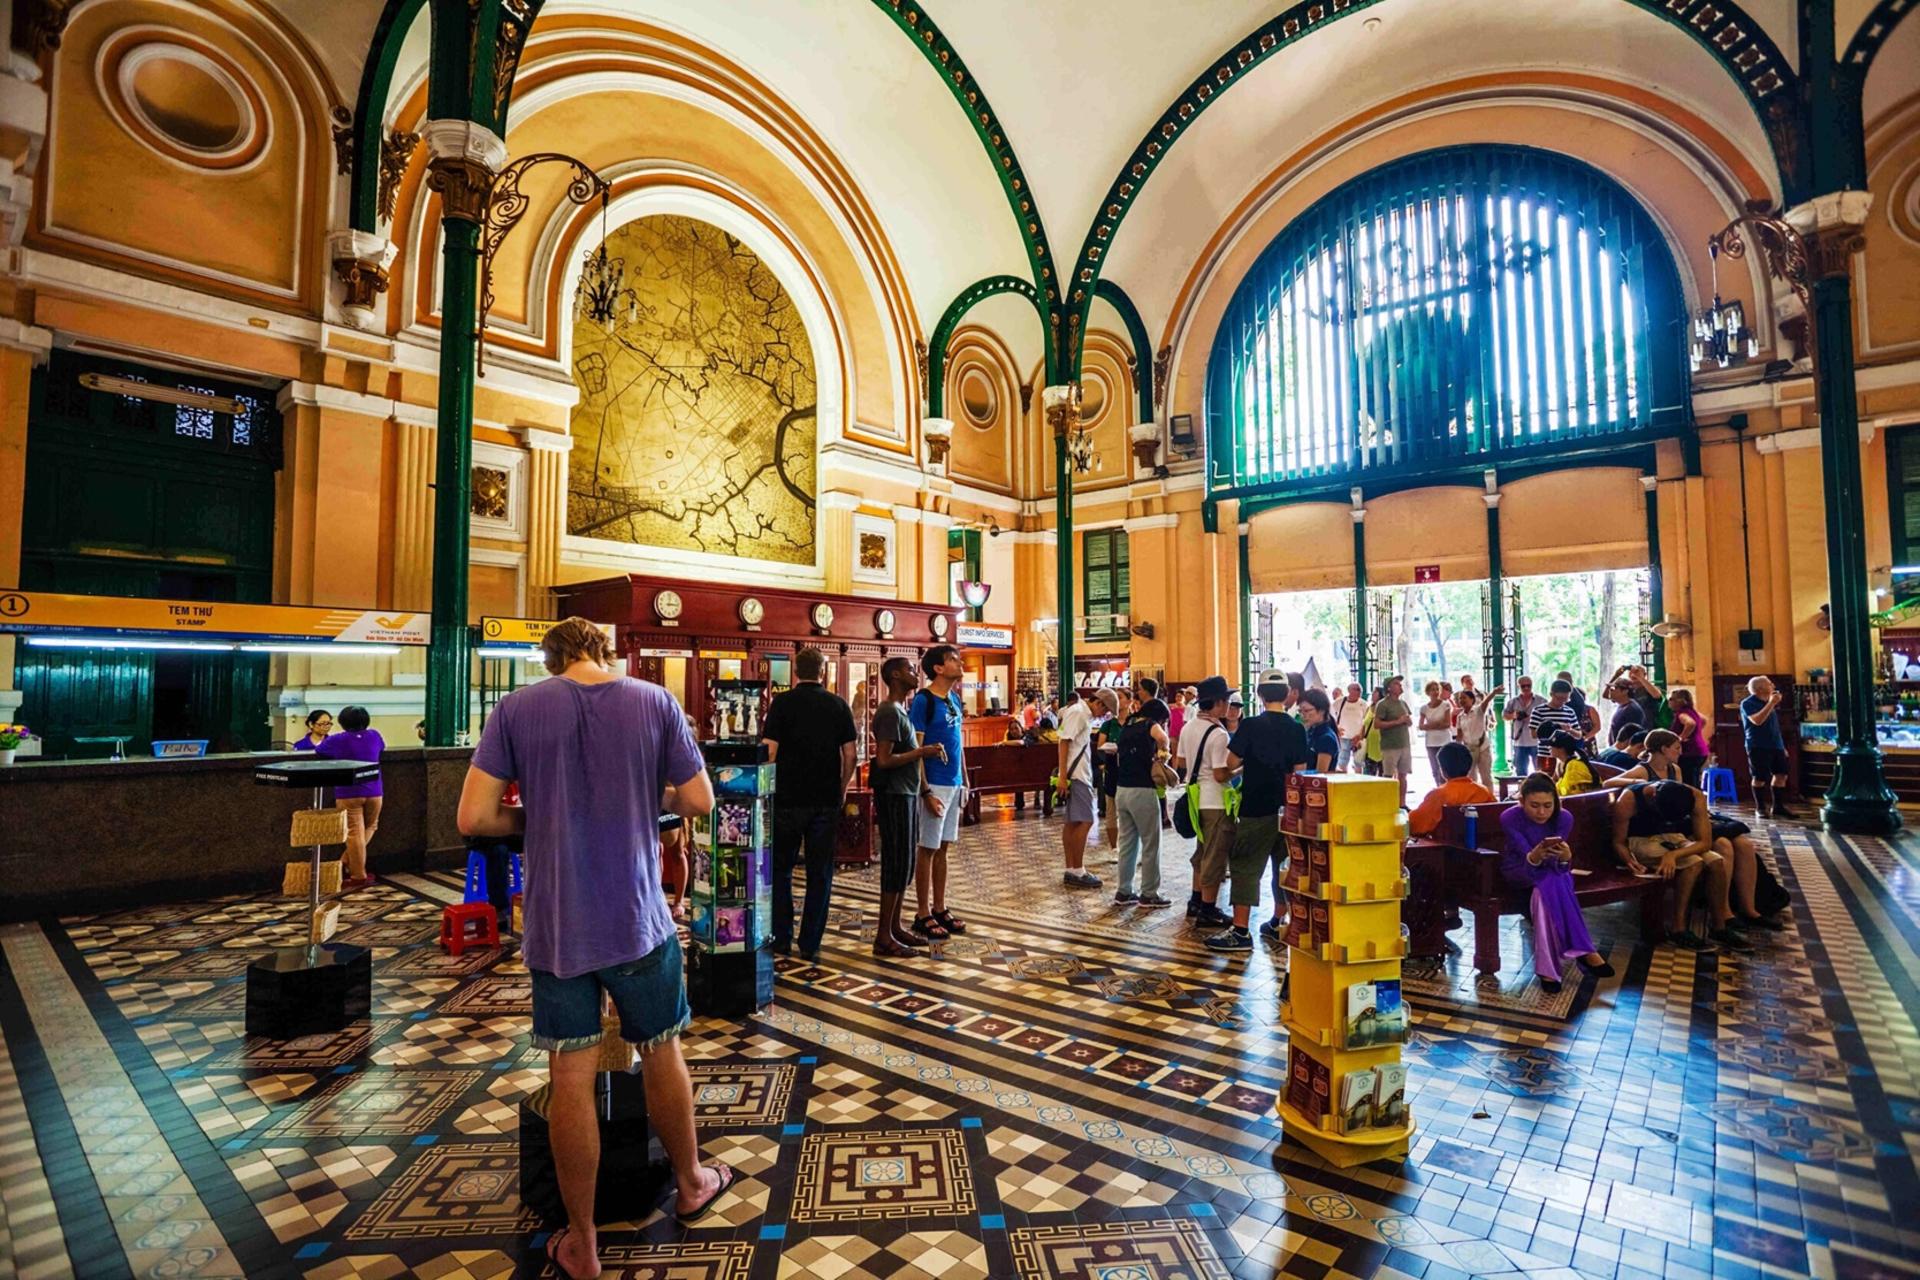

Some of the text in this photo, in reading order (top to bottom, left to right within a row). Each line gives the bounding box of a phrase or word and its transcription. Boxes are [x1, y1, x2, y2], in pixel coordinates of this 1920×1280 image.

[8, 598, 17, 611] 1
[168, 605, 214, 617] TEM THƯ
[975, 629, 985, 637] INFO
[986, 630, 1005, 638] SERVICES
[649, 661, 656, 670] 8
[708, 661, 715, 671] 9
[759, 662, 768, 672] 10
[771, 685, 791, 693] ATM
